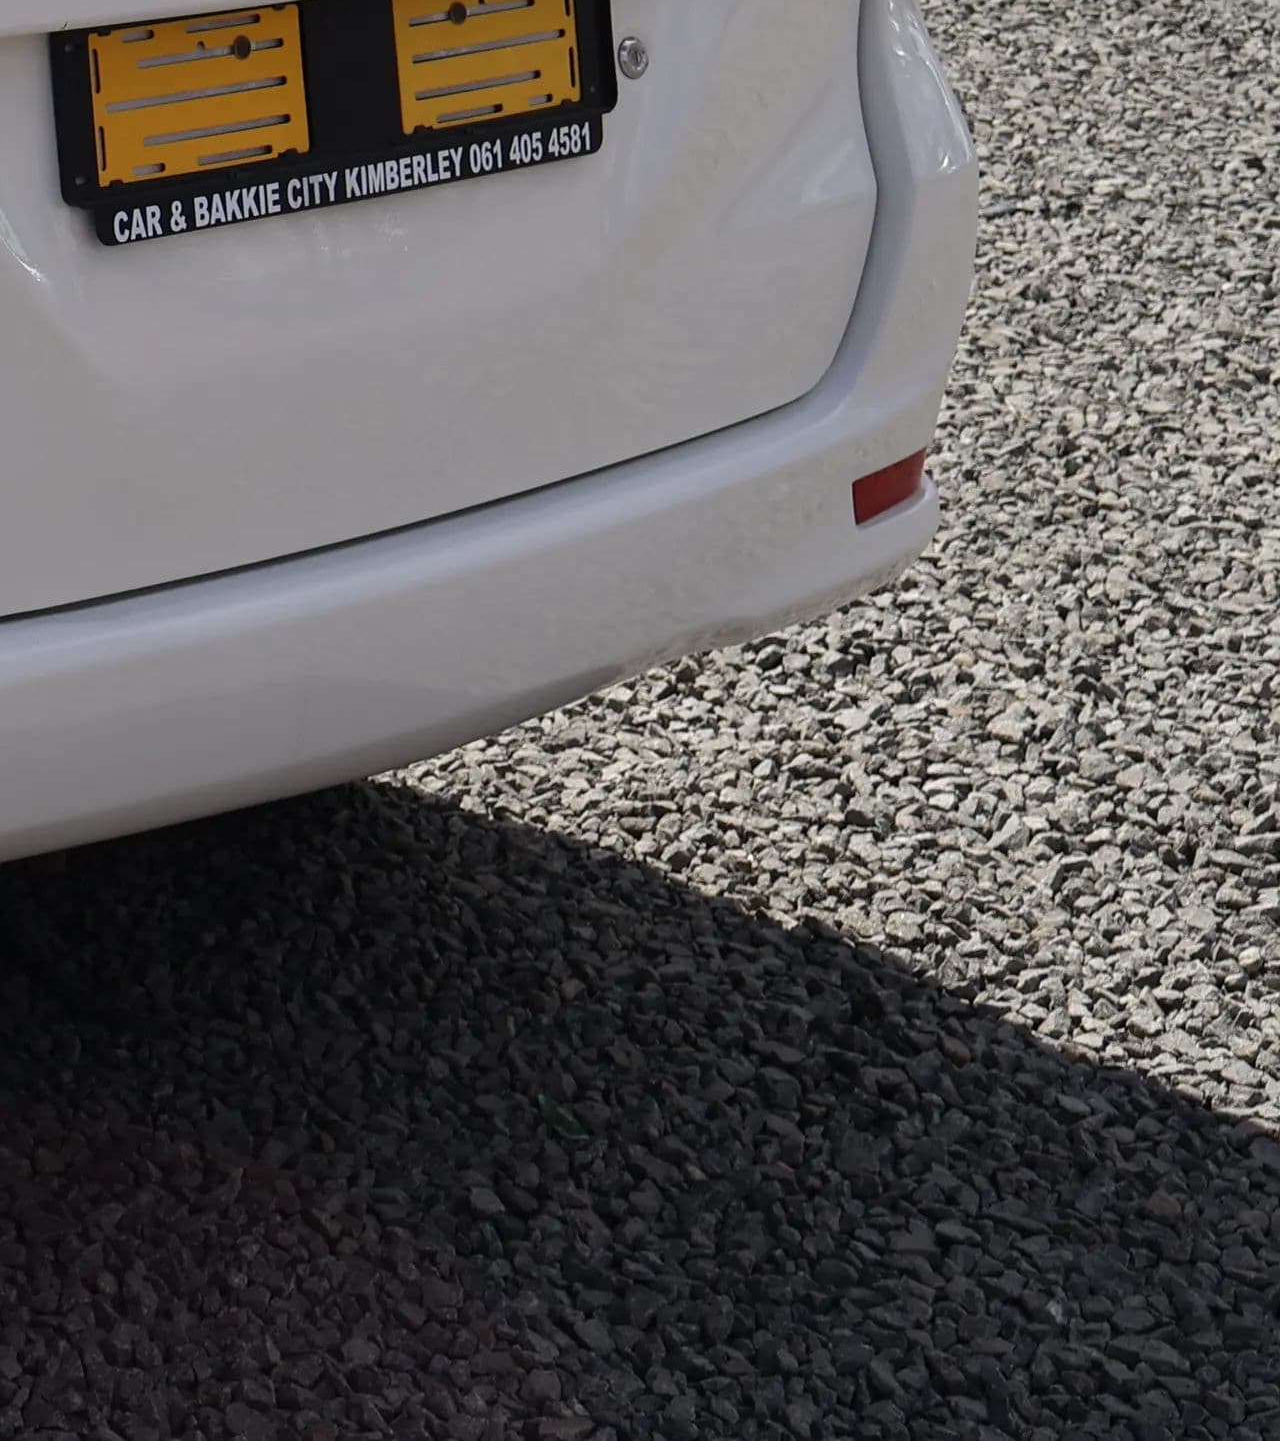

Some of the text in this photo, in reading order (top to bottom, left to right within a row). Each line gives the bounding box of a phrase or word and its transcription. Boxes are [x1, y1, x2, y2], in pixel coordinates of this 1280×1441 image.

[113, 122, 591, 243] CAR & BAKKIE CITY KIMBERLEY 061 405 4581
